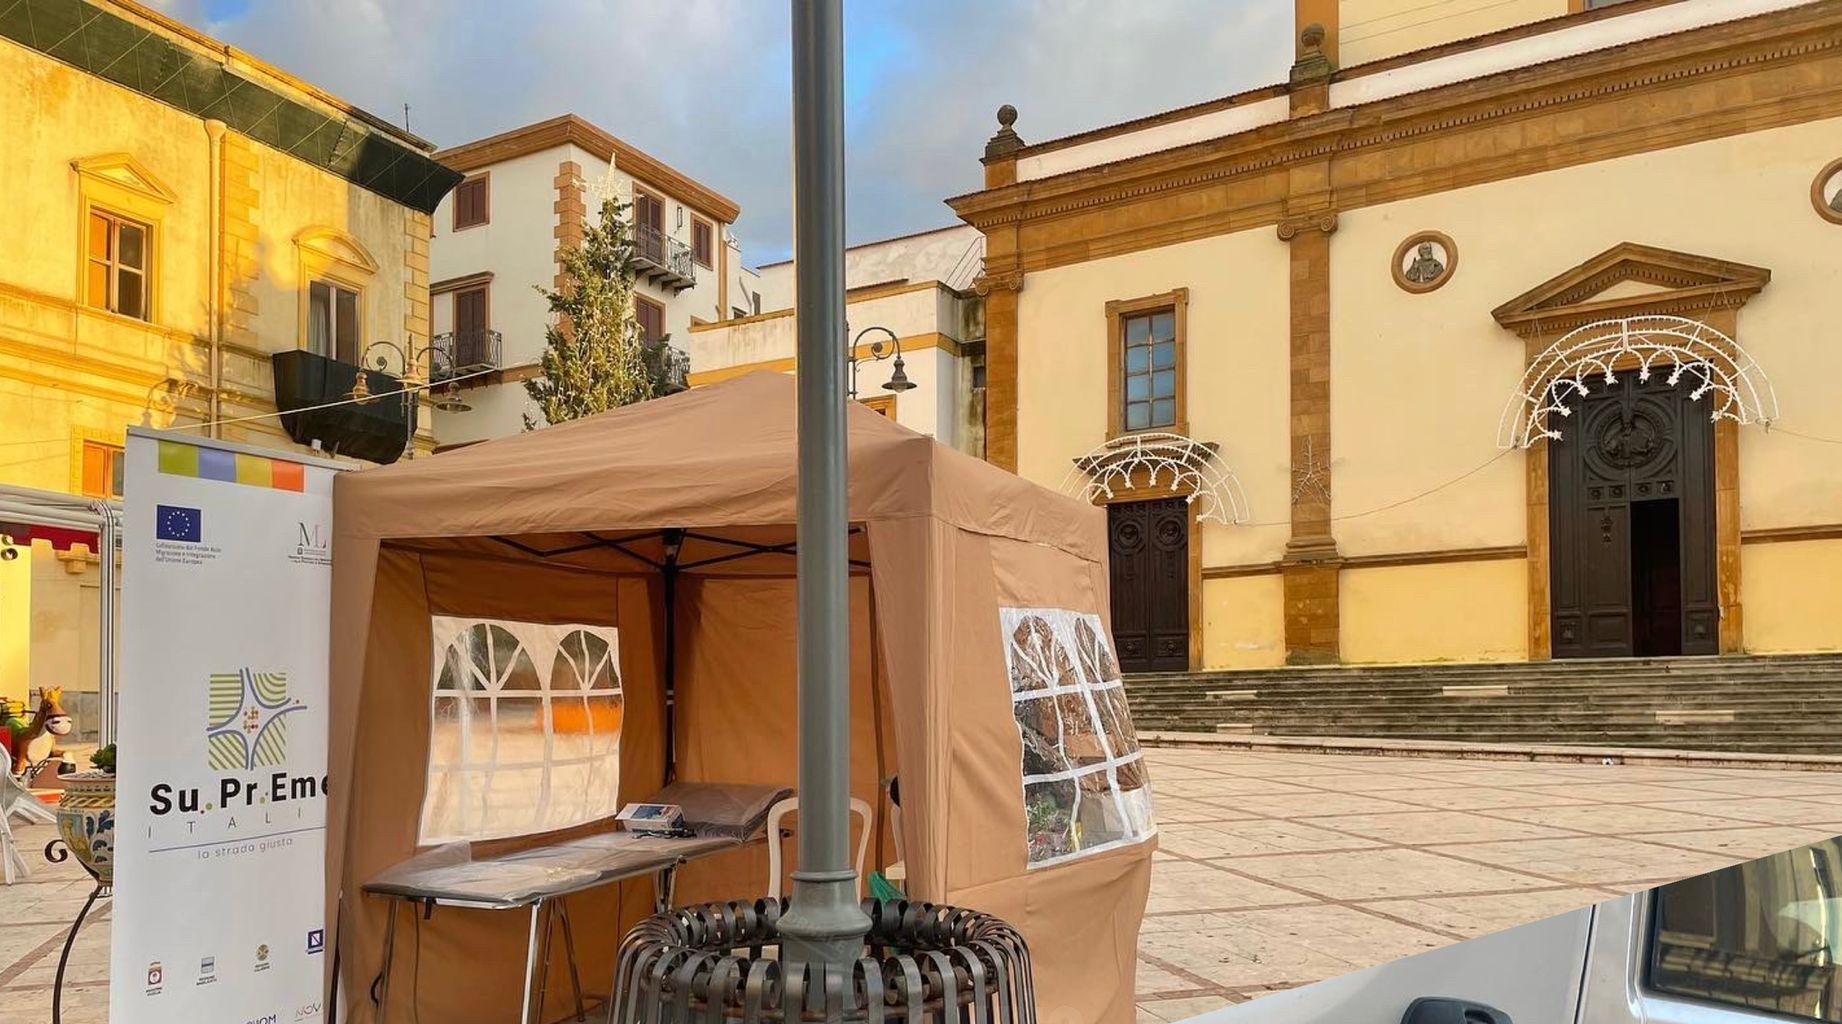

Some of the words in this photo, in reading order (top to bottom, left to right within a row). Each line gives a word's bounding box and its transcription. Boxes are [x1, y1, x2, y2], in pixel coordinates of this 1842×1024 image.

[198, 849, 209, 859] la
[215, 842, 255, 858] strada
[259, 837, 293, 852] giusta
